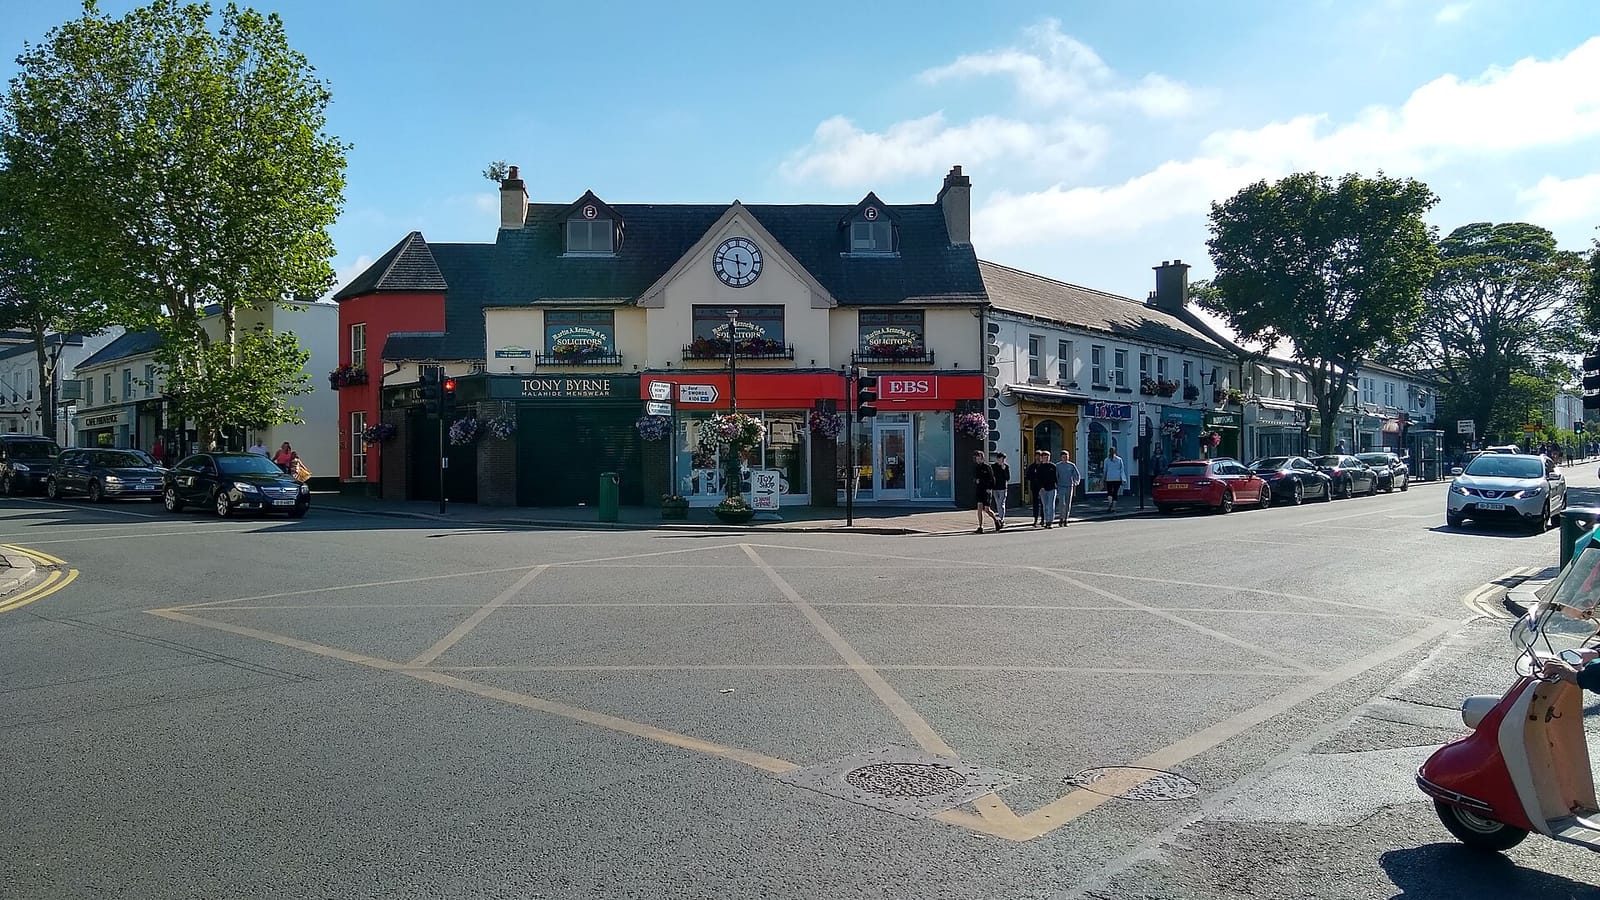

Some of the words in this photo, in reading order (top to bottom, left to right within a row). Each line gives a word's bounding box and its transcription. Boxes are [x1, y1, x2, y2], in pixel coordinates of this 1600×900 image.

[716, 331, 761, 339] SOLCITORS
[557, 338, 602, 346] SOLICITORS
[869, 338, 913, 346] SOLICITORS
[521, 379, 562, 391] TONY
[566, 379, 610, 391] BYRNE
[889, 380, 929, 394] EBS
[758, 474, 774, 483] TOY
